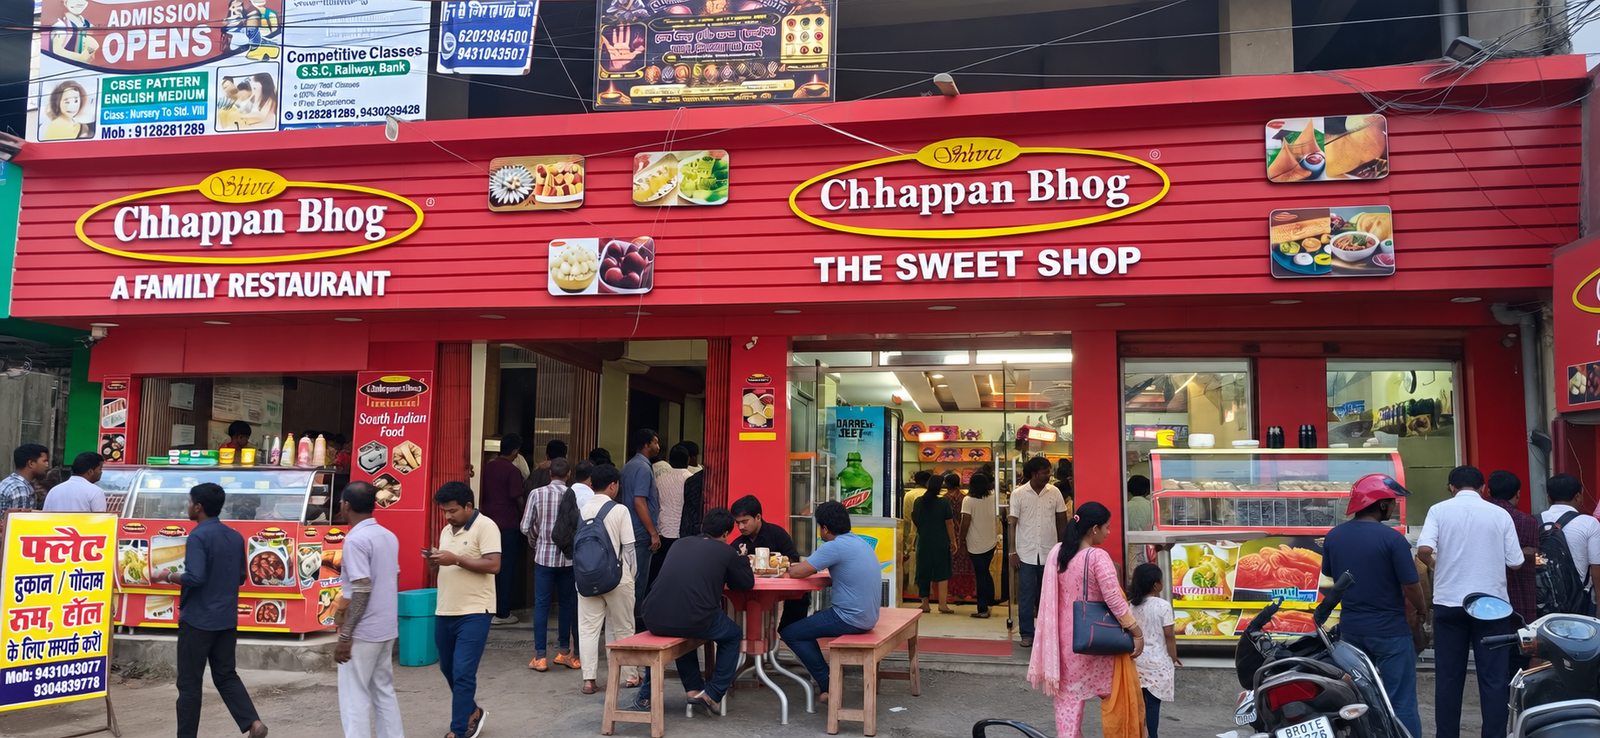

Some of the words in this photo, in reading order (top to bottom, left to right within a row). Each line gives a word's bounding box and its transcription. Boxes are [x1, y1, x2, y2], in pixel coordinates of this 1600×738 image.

[107, 2, 210, 27] ADMISSION
[102, 24, 212, 64] OPENS
[458, 29, 528, 43] 6202984500
[287, 48, 366, 65] Competitive
[369, 45, 422, 59] Classes
[457, 47, 525, 60] 9431043507
[379, 61, 406, 73] Bank
[110, 79, 142, 90] CBSE
[146, 76, 200, 89] PATTERN
[104, 91, 154, 104] ENGLISH
[158, 88, 205, 102] MEDIUM
[130, 109, 160, 120] Nursery
[161, 107, 172, 117] To
[173, 105, 190, 117] Std.
[101, 126, 125, 139] Mob
[135, 123, 205, 138] 9128281289
[819, 175, 1015, 216] Chhappan
[1026, 167, 1131, 209] Bhog
[113, 204, 285, 246] Chhappan
[296, 197, 388, 241] Bhog
[813, 254, 883, 284] THE
[895, 249, 1024, 282] SWEET
[1037, 246, 1142, 277] SHOP
[110, 275, 130, 300] A
[133, 272, 221, 299] FAMILY
[227, 270, 391, 298] RESTAURANT
[393, 411, 427, 425] Indian
[379, 425, 405, 438] Food
[19, 526, 107, 564] फ्लैट
[14, 573, 55, 603] दुकान
[21, 636, 46, 660] लिए
[5, 669, 33, 684] Mob:
[35, 660, 101, 680] 9431043077
[33, 676, 100, 697] 9304839778
